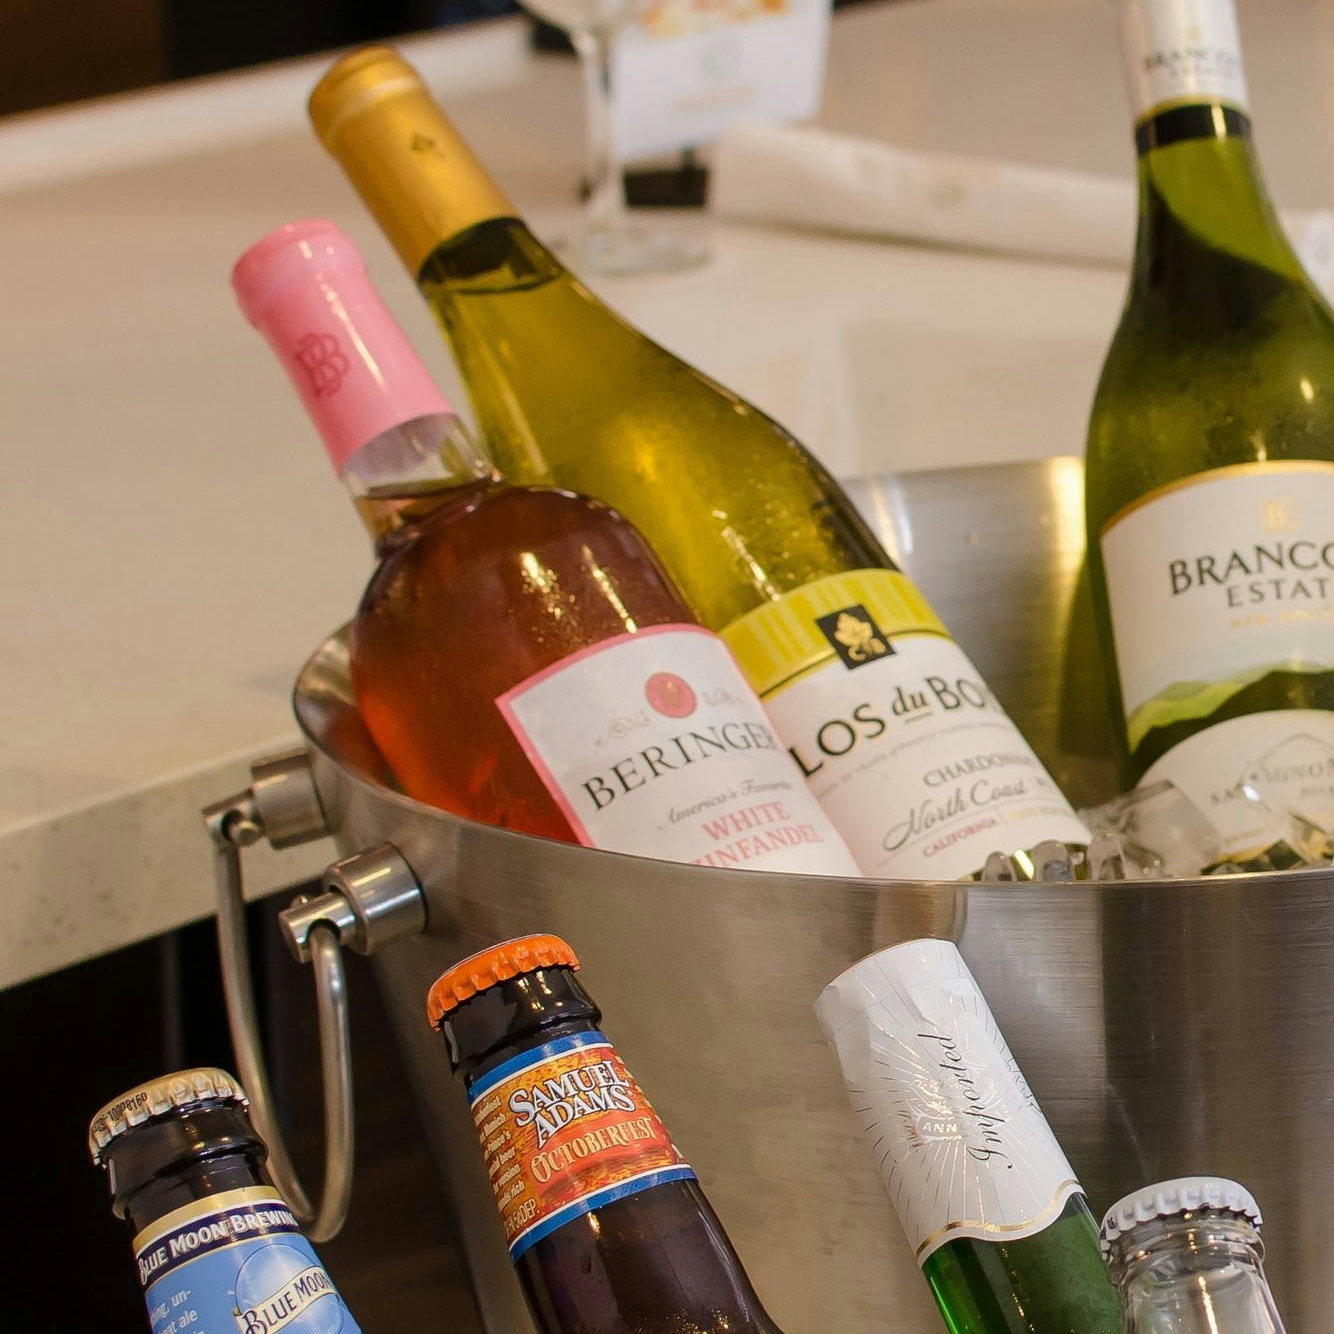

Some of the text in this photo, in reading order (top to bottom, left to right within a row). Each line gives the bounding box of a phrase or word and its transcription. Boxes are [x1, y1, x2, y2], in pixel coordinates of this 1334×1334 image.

[788, 703, 887, 777] LOS
[892, 685, 929, 717] du
[692, 824, 826, 867] INFANDEL
[701, 801, 792, 842] WHITE
[882, 786, 966, 852] North
[508, 1060, 631, 1126] SAMUEL
[534, 1085, 637, 1149] ADAMS
[530, 1117, 657, 1184] OCTOBERFEST
[168, 1220, 229, 1258] MOON
[178, 1308, 198, 1329] ale
